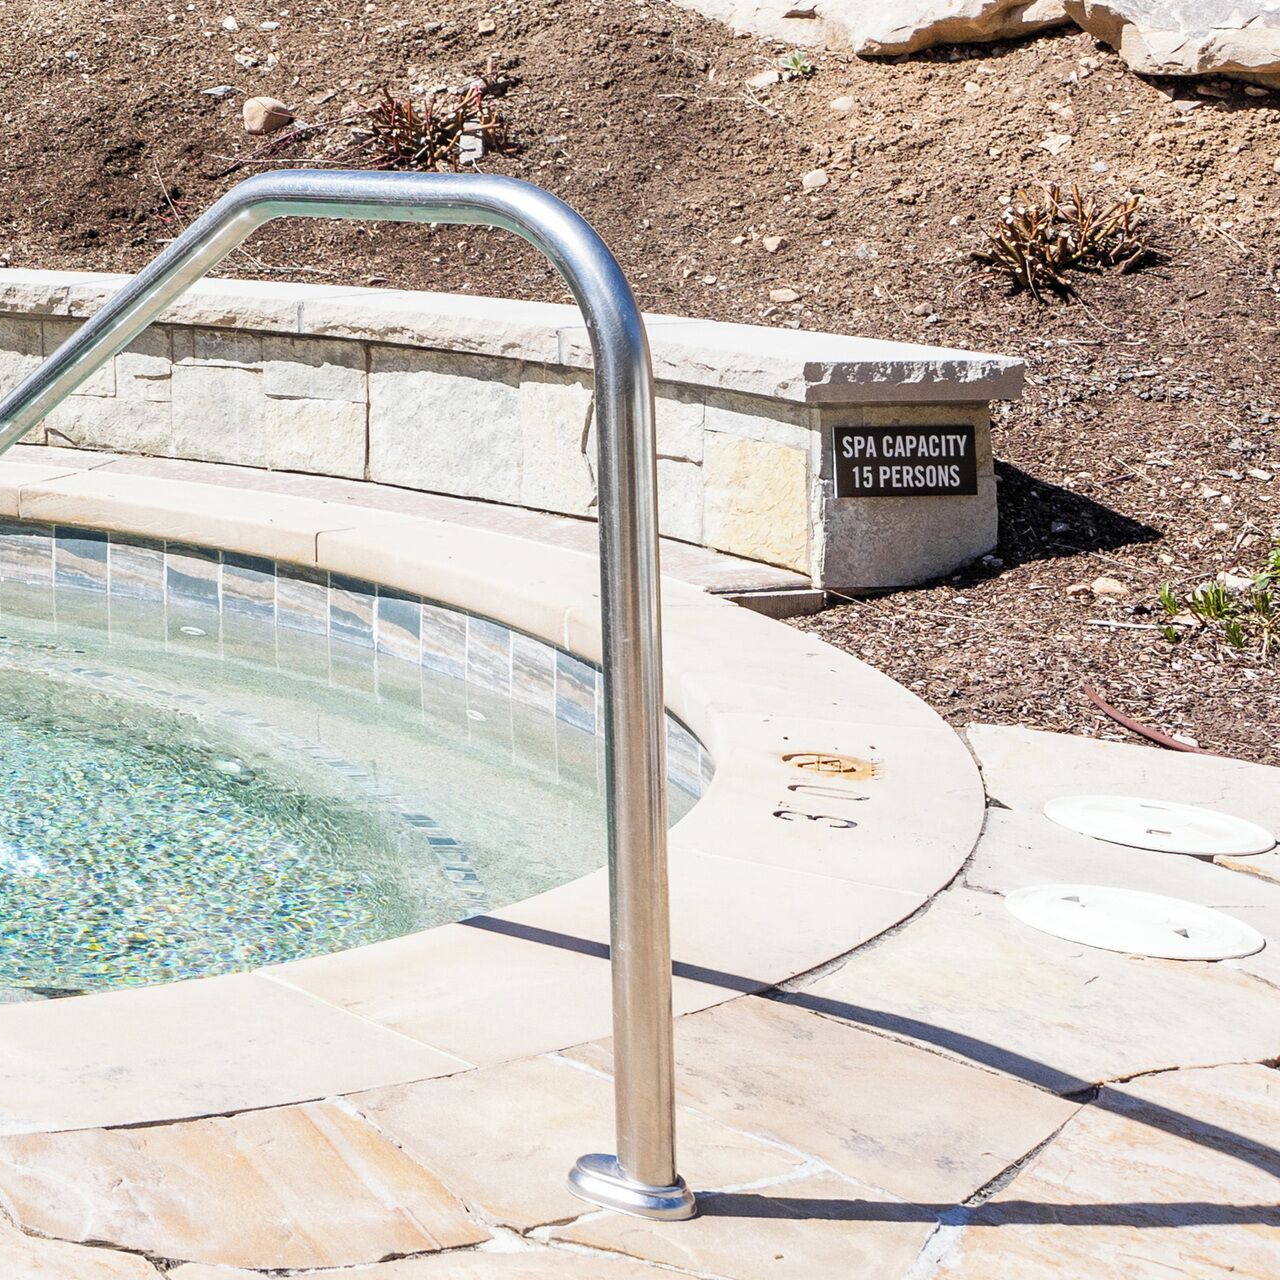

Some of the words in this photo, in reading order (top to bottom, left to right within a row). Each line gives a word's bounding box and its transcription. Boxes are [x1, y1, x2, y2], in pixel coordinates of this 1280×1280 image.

[842, 436, 877, 458] SPA
[882, 434, 968, 458] CAPACITY
[852, 466, 872, 488] 15
[879, 464, 961, 488] PERSONS
